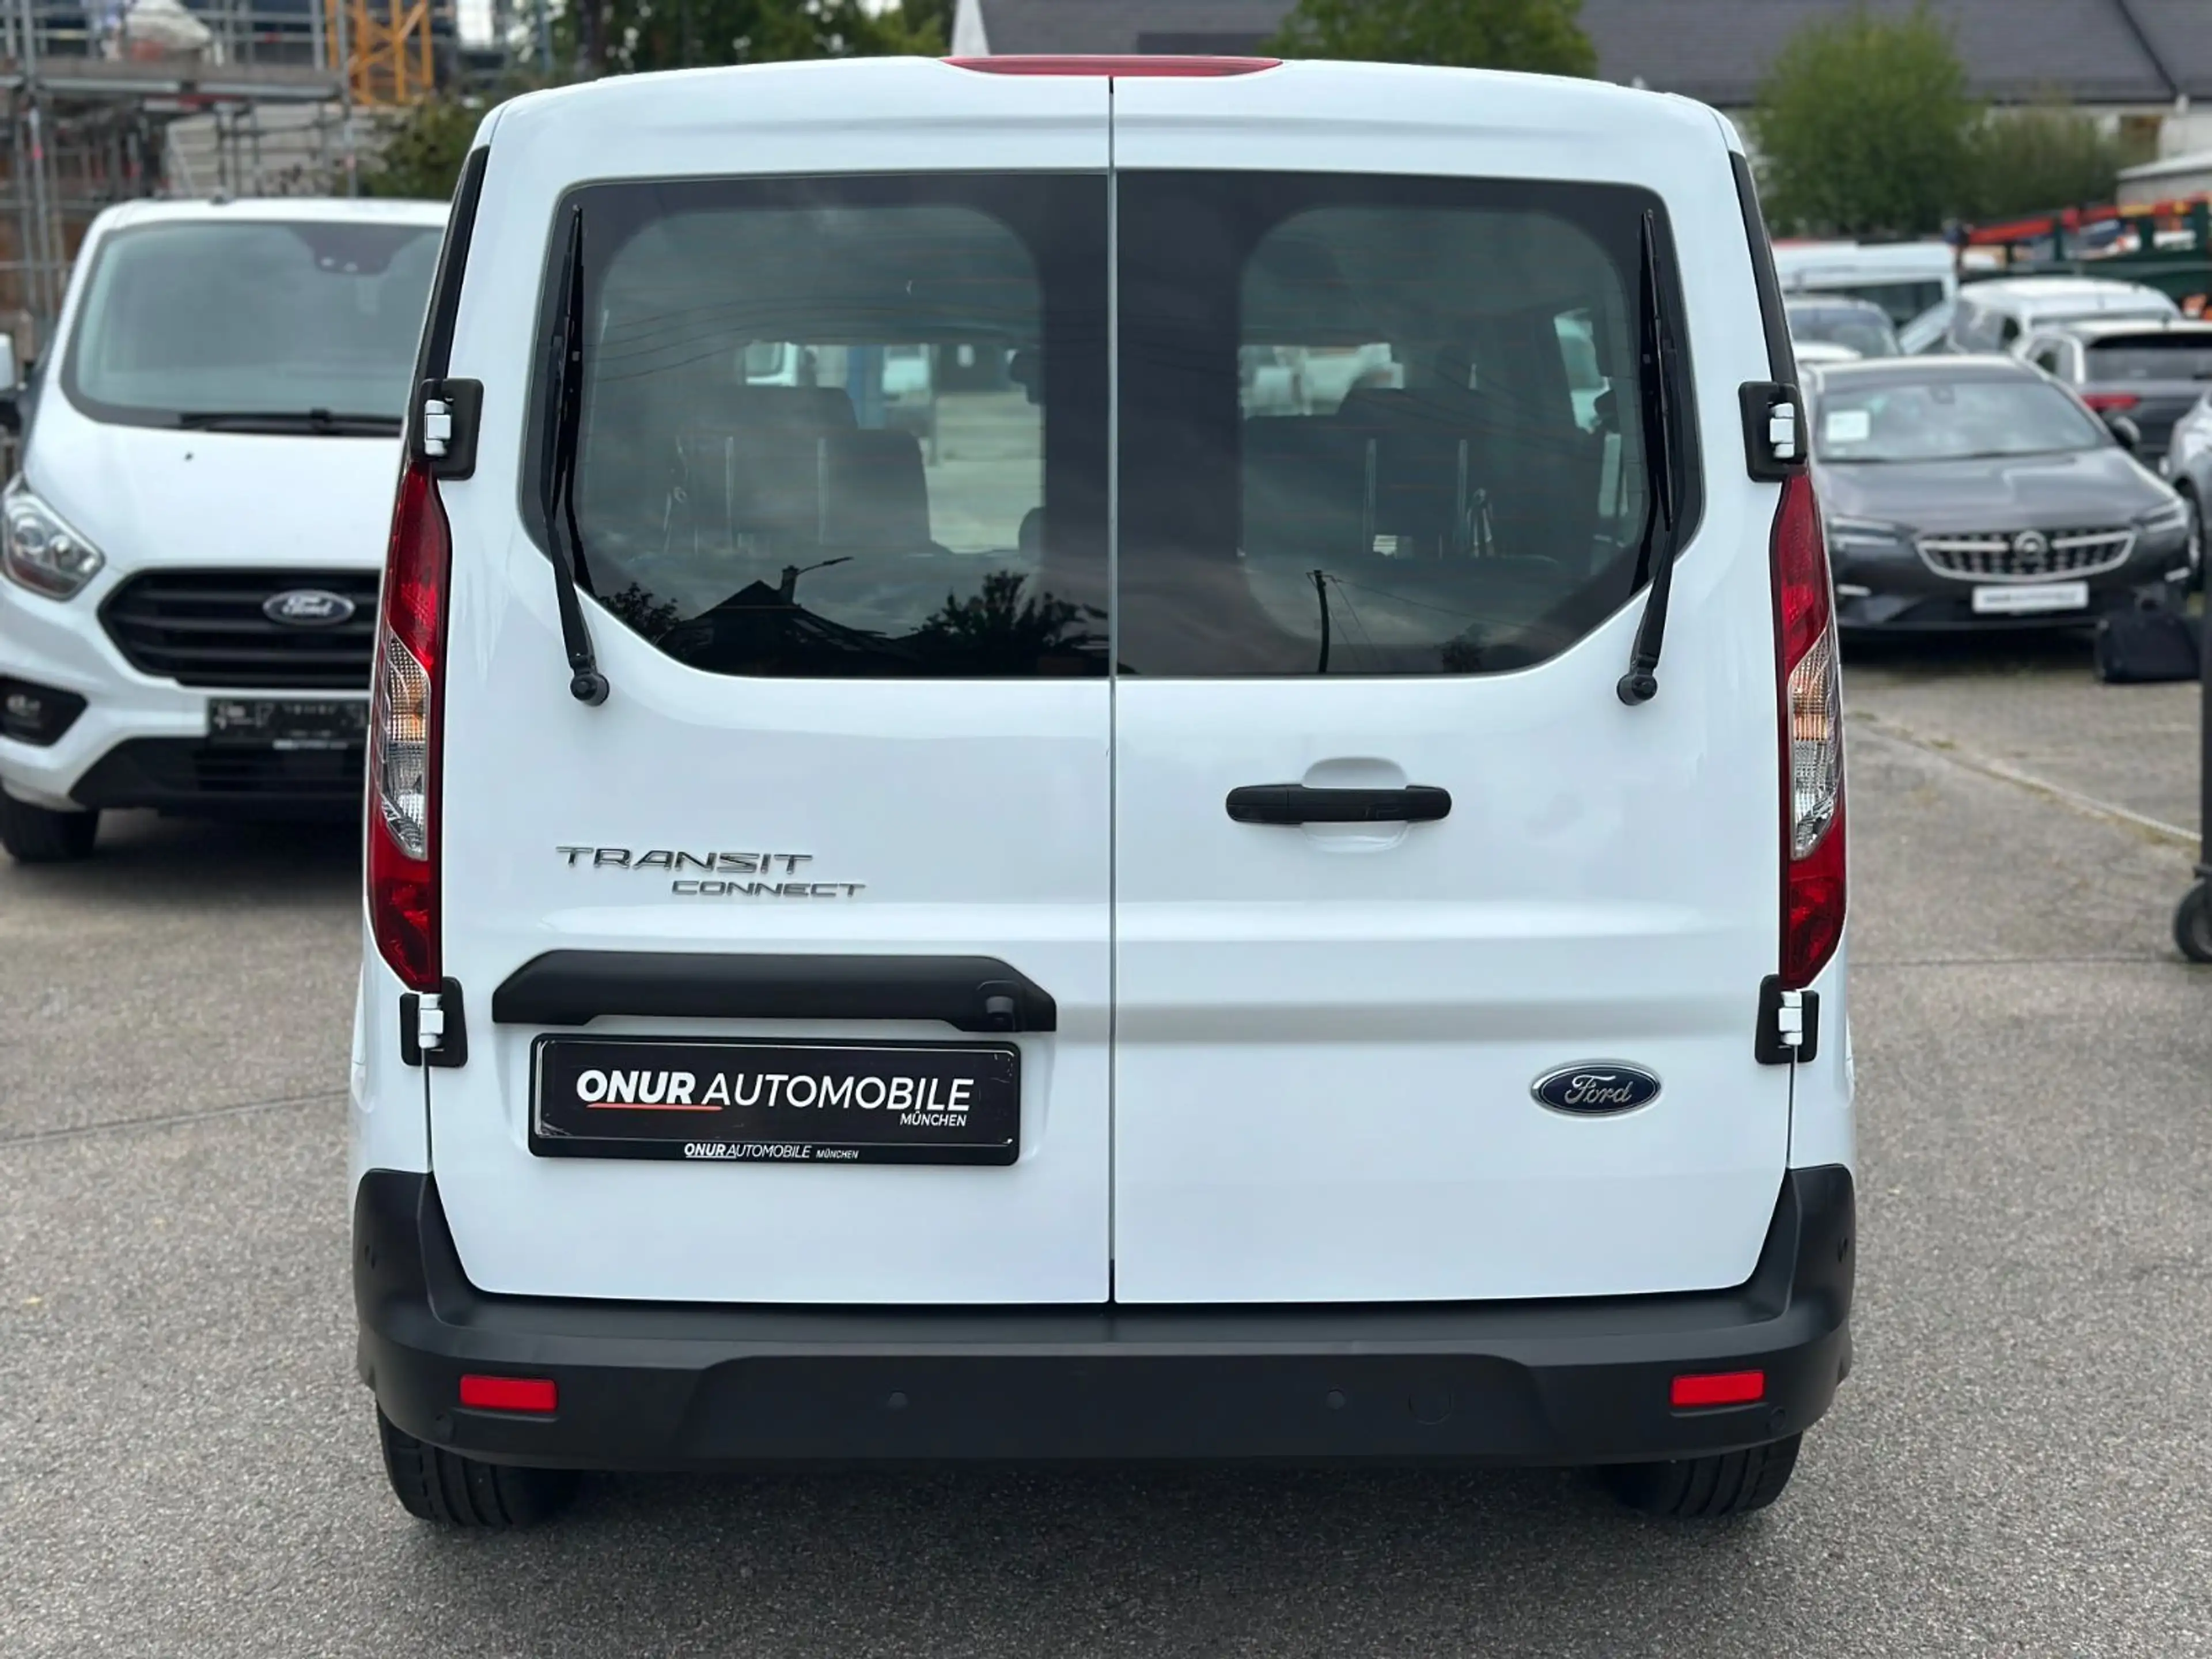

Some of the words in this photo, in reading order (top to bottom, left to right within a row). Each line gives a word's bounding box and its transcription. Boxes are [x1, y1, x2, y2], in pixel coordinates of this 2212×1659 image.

[555, 846, 813, 874] TRANSIT
[672, 880, 866, 897] CONNECT
[577, 1070, 696, 1104] ONUR
[700, 1073, 975, 1111] AUTOMOBILE
[1564, 1074, 1633, 1104] Ford
[899, 1111, 968, 1127] MÜNCHEN
[684, 1143, 725, 1157] ONUR
[725, 1144, 813, 1158] AUTOMOBILE
[815, 1147, 860, 1160] MÜNCHEN
